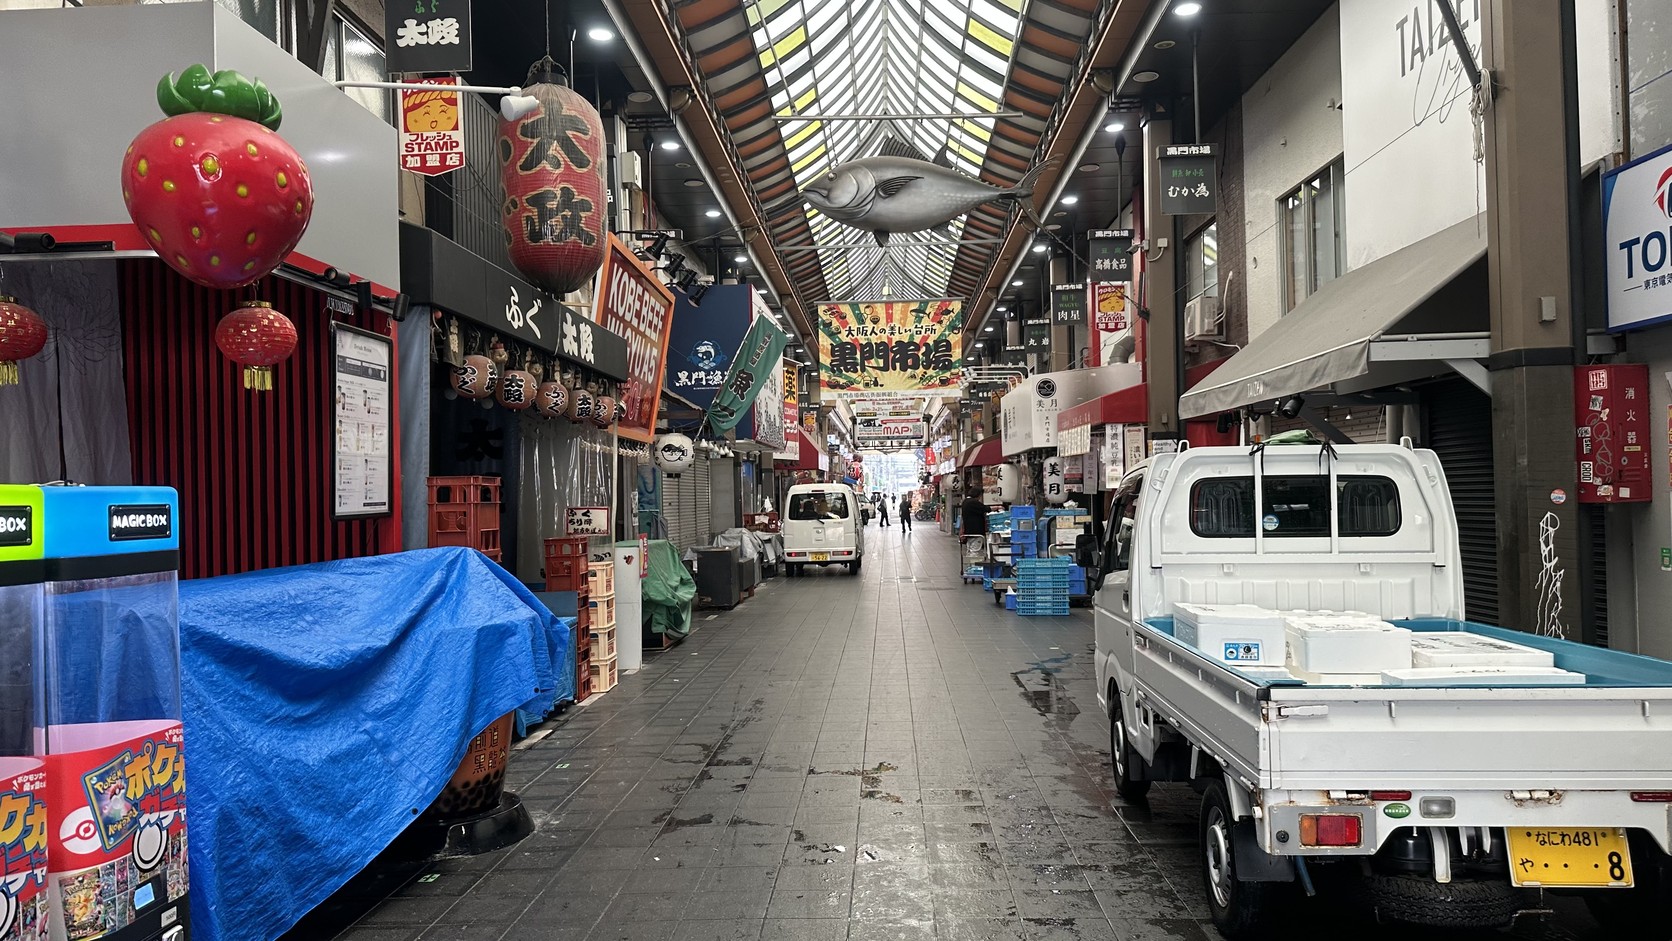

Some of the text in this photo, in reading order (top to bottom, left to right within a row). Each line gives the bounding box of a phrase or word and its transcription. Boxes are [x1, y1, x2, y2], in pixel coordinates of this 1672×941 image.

[396, 18, 459, 47] 太政
[404, 141, 460, 153] STAMP
[408, 133, 453, 141] フレッシュ
[405, 153, 461, 168] 加盟店
[516, 97, 597, 246] 太政
[1619, 226, 1672, 279] TO
[506, 286, 542, 340] ふぐ
[608, 263, 665, 343] KOBE BEEF
[845, 323, 937, 338] 大阪人の美しい台所
[640, 346, 658, 384] A5
[829, 339, 953, 374] 黒門市場
[674, 369, 729, 387] 黒門漁
[545, 385, 565, 414] ふぐ
[1625, 387, 1637, 443] 消火器
[883, 426, 910, 435] MAP
[1048, 462, 1061, 495] 美月
[1607, 851, 1625, 881] 8
